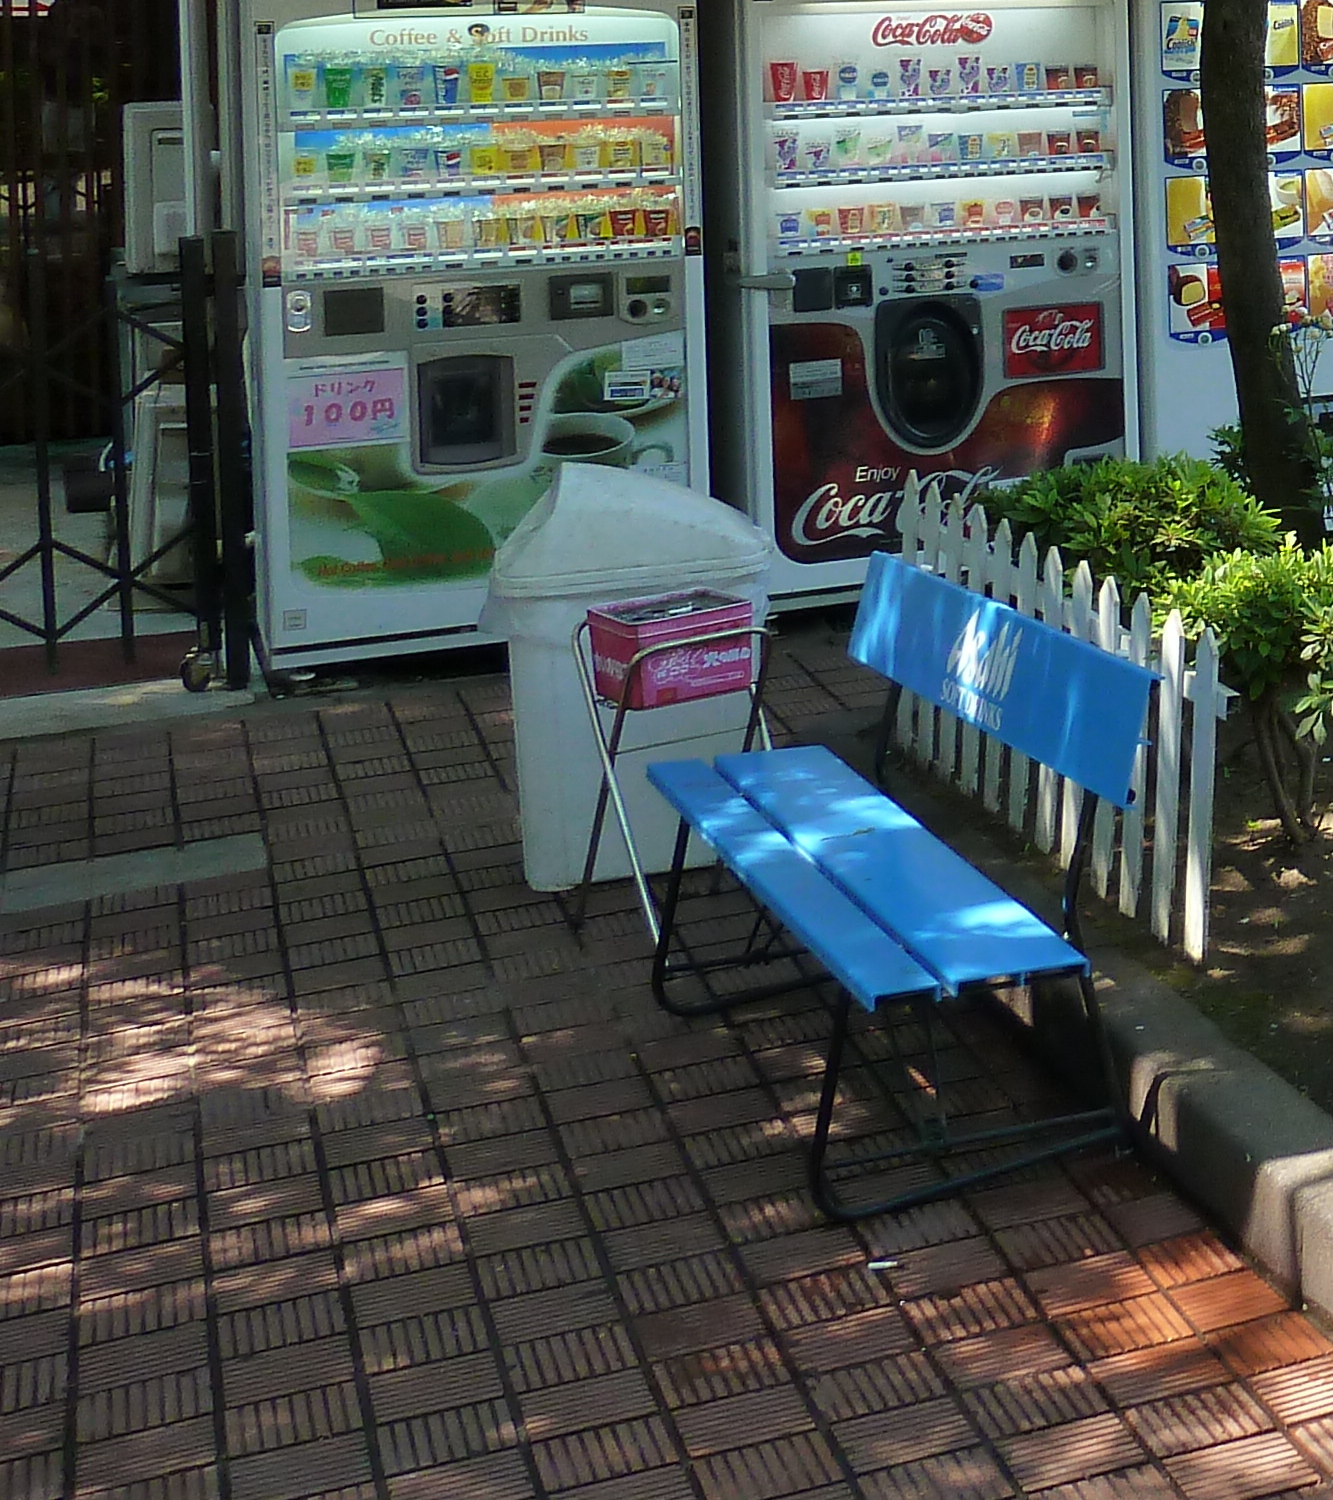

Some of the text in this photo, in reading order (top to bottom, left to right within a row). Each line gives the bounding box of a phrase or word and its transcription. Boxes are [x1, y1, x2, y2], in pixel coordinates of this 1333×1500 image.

[369, 25, 588, 46] Coffee & Soft Drinks
[872, 12, 963, 47] Coca-Cola
[1011, 319, 1093, 354] Coca-Cola
[315, 380, 375, 397] ドリンク
[304, 398, 395, 426] 100円
[854, 465, 900, 483] Enjoy
[946, 608, 1024, 701] Asahi
[940, 677, 963, 711] SOFT
